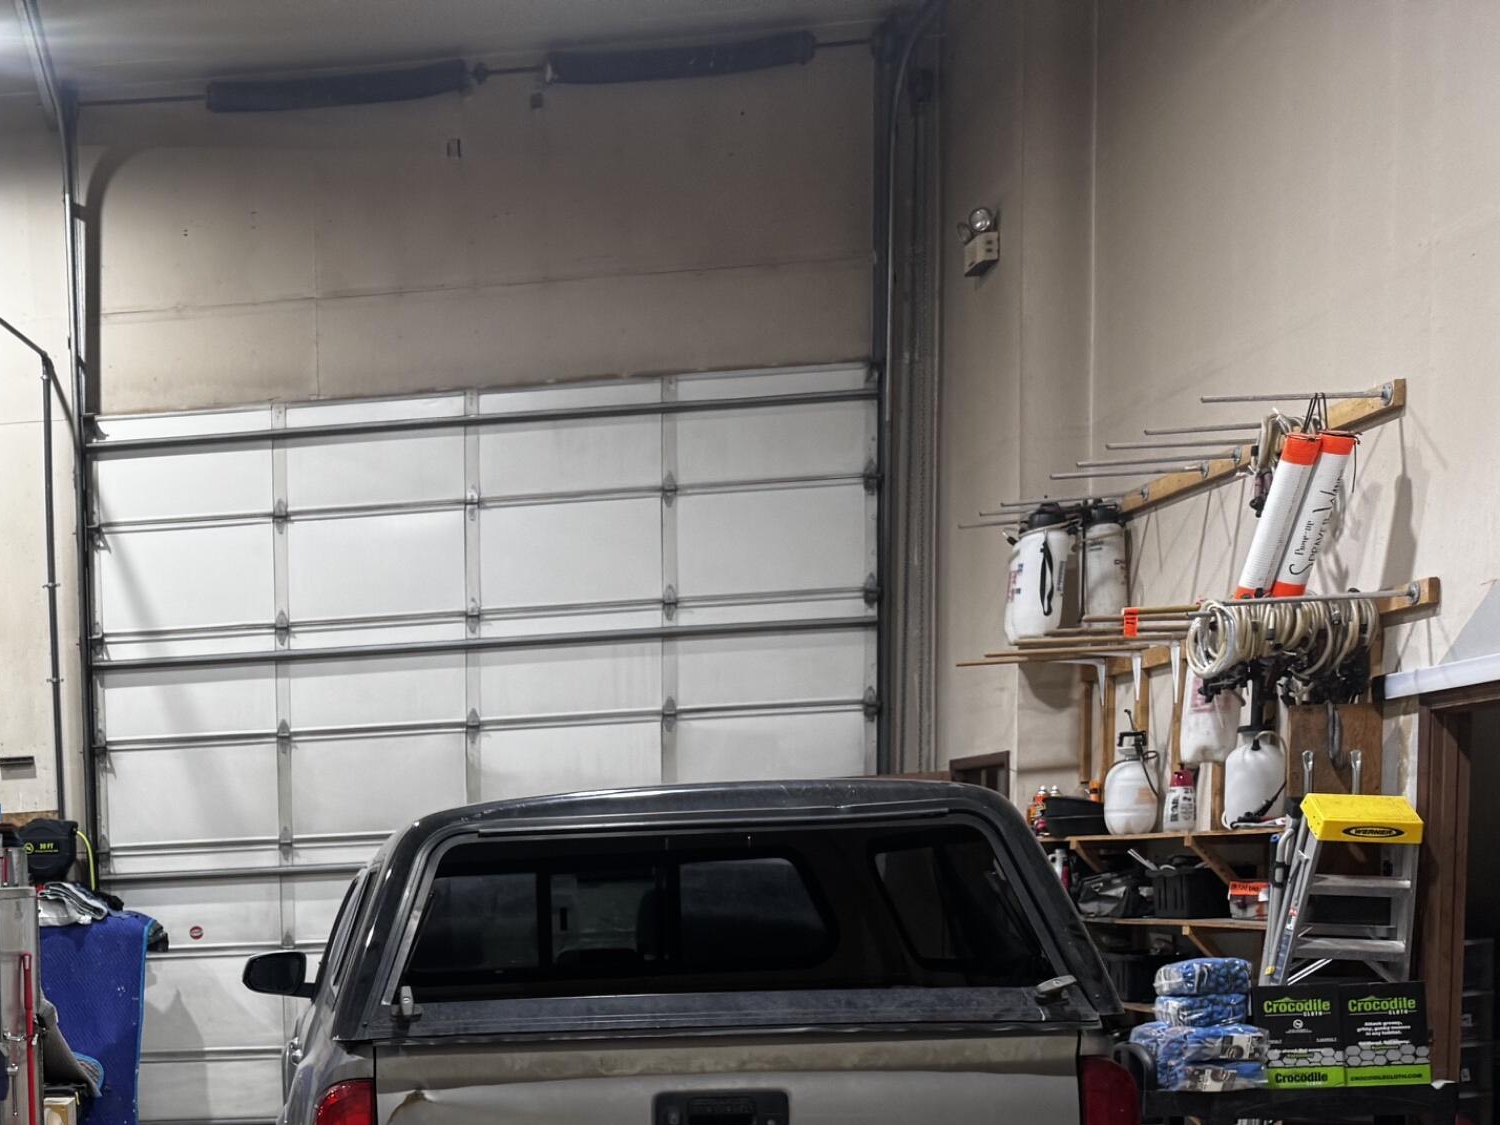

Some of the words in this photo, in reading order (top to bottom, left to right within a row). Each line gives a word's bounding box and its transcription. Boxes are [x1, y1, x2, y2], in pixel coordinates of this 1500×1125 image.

[1263, 998, 1331, 1013] Crocodile
[1348, 998, 1416, 1012] Crocodile
[1275, 1072, 1328, 1083] Crocodile
